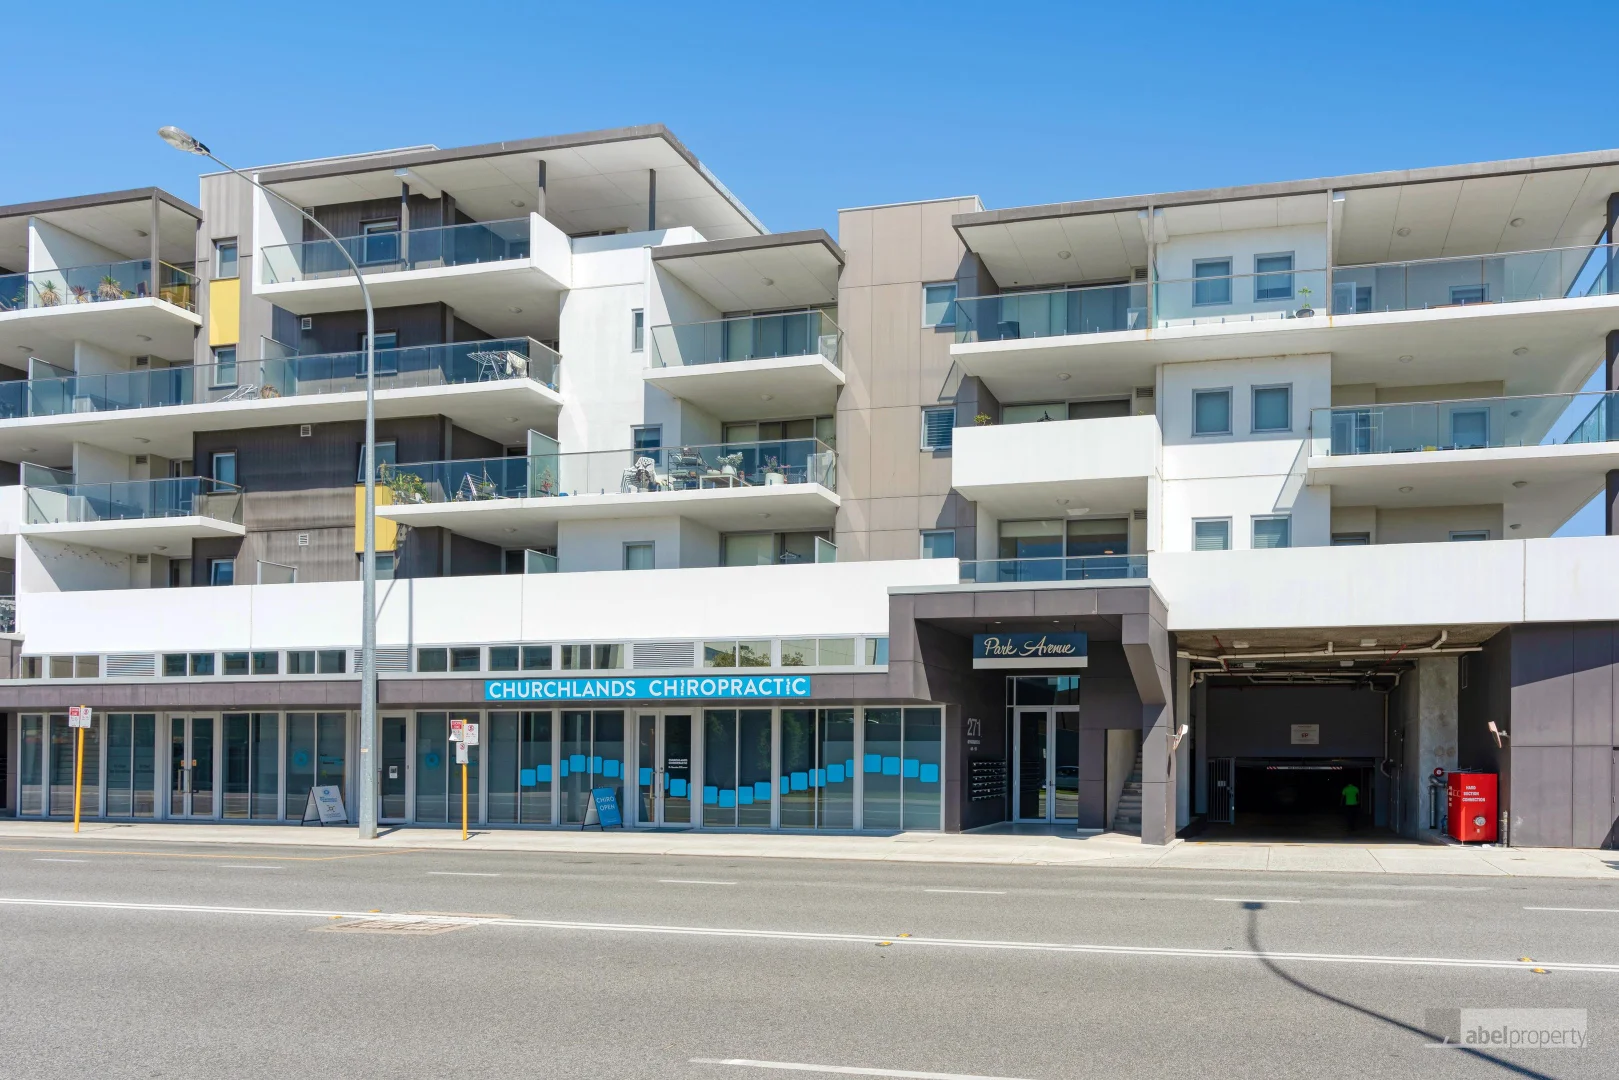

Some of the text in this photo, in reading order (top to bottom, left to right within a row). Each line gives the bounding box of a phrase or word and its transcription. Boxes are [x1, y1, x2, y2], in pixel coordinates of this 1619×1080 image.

[984, 635, 1075, 656] Park Avenue
[489, 680, 636, 698] CHURCHLANDS
[967, 718, 981, 737] 271
